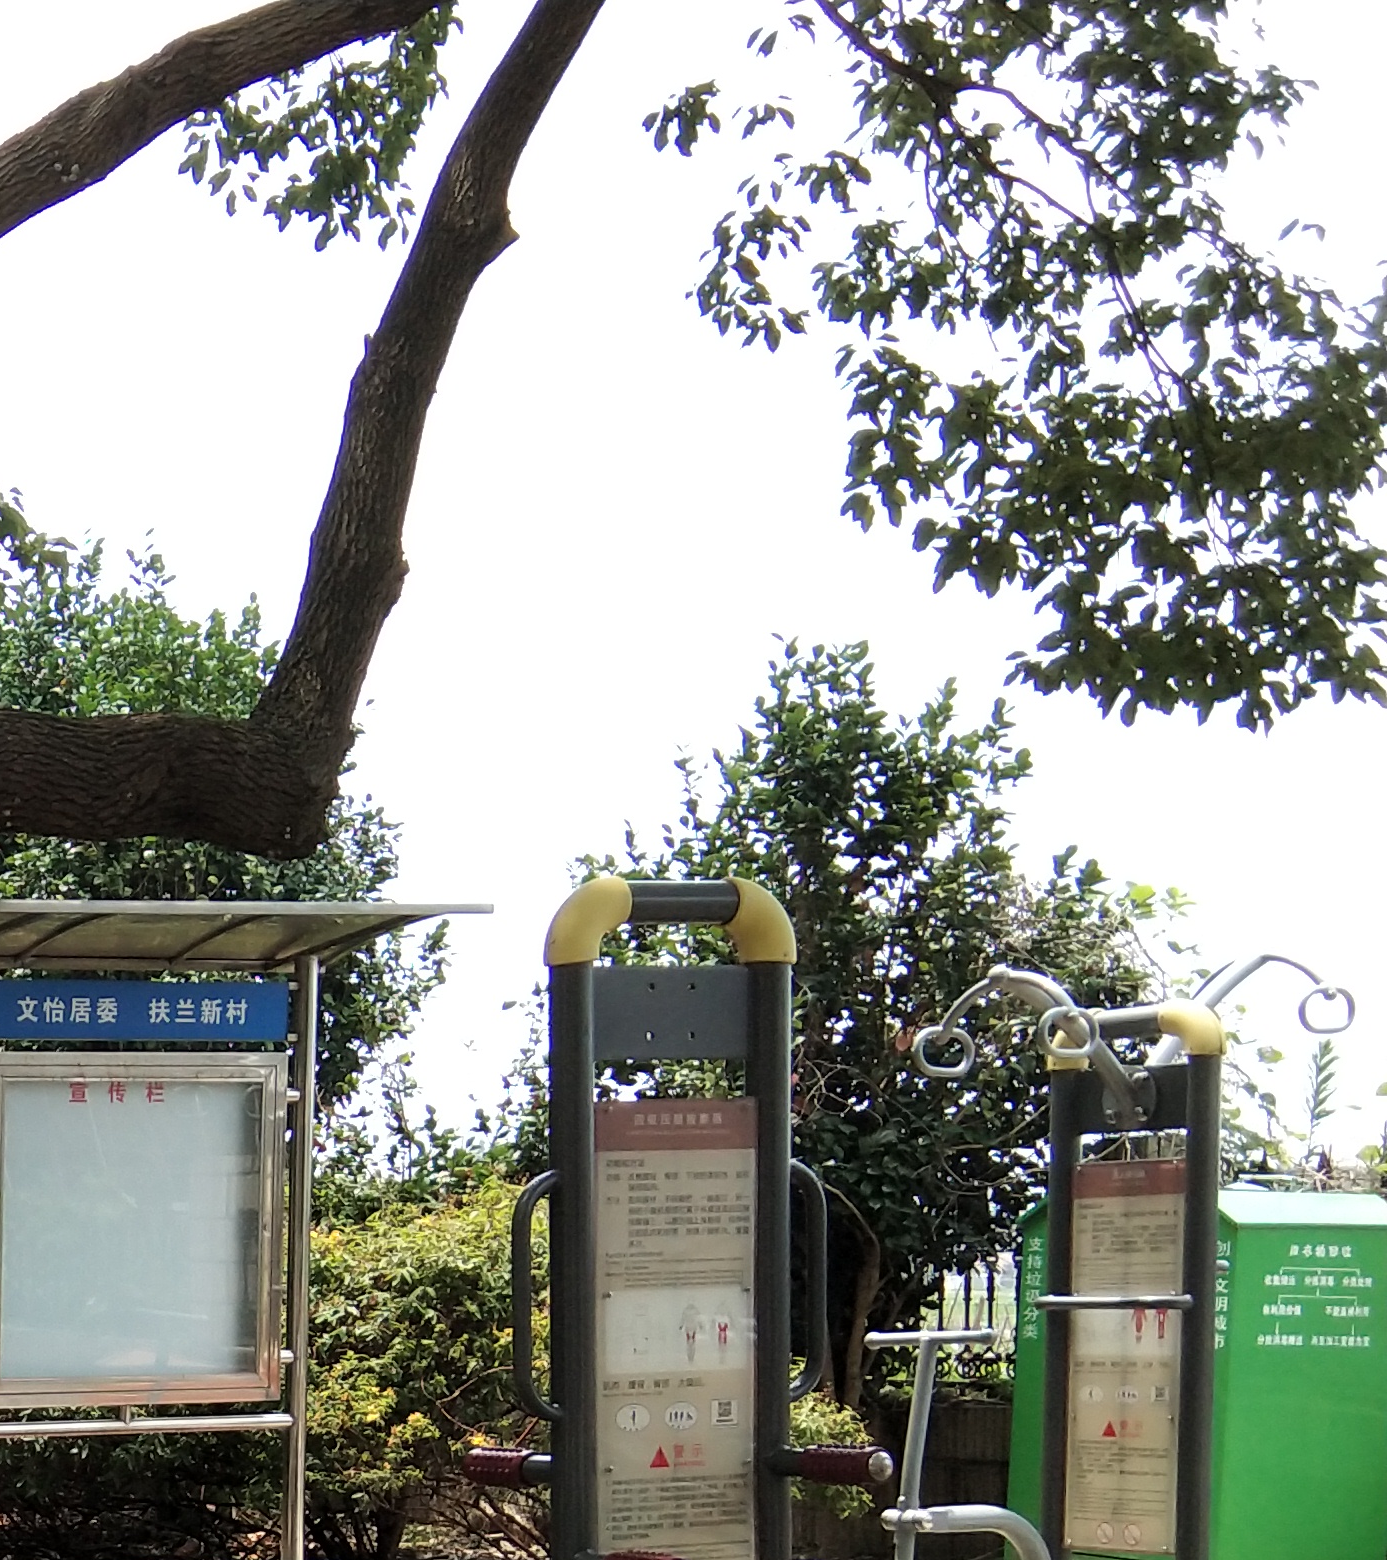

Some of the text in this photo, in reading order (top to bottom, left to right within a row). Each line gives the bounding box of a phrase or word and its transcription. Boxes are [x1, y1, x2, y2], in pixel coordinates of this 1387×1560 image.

[16, 996, 248, 1025] 文怡居委 扶兰新村
[69, 1081, 165, 1104] 宣传栏
[1022, 1237, 1044, 1340] 支持垃圾分类
[1214, 1240, 1231, 1350] 创文明城市
